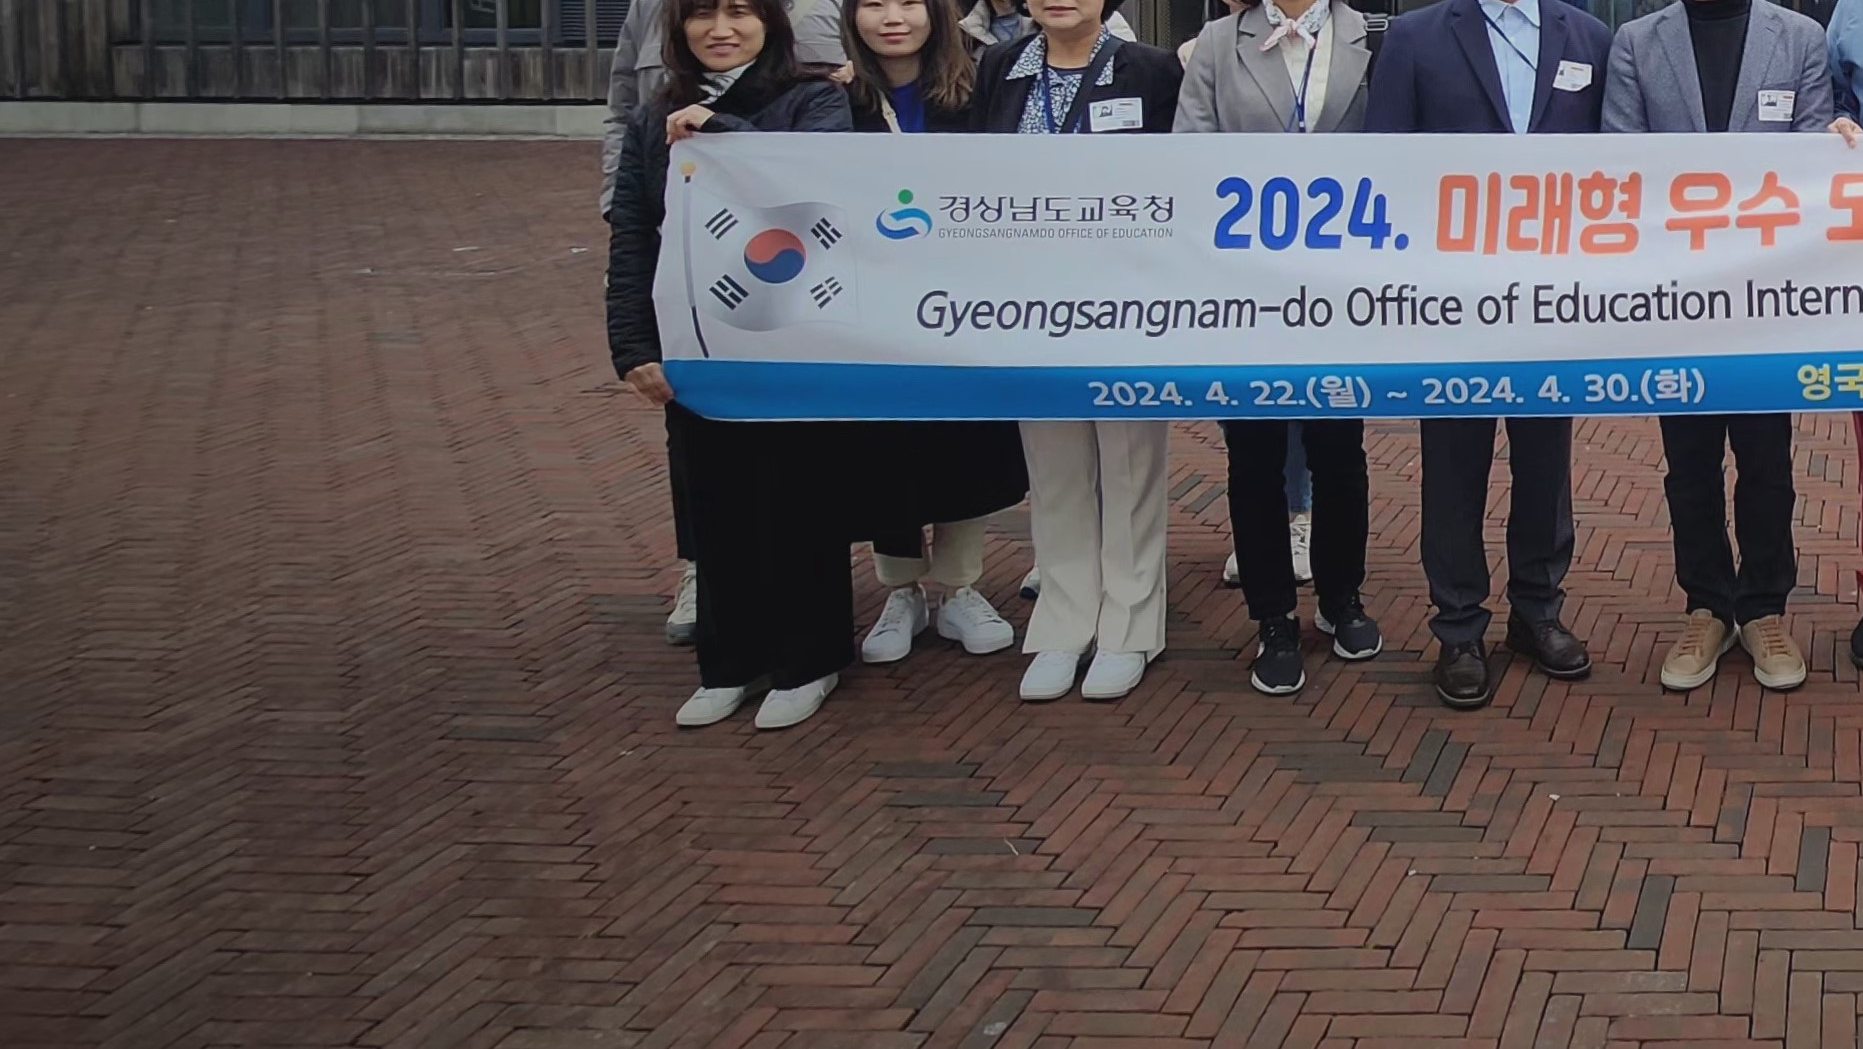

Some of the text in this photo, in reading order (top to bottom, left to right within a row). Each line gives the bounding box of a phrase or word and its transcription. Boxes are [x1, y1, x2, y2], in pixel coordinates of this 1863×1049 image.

[938, 194, 1175, 223] 경상남도교육청
[1213, 176, 1410, 251] 2024.
[1435, 172, 1642, 255] 미래형
[1664, 170, 1801, 250] 우수
[938, 227, 1174, 239] GYEONGSANGNAMDO OFFICE OF EDUCATION
[916, 285, 1334, 337] Gyeongsangnam-do
[1346, 284, 1463, 327] Office
[1477, 282, 1519, 325] of
[1532, 280, 1732, 325] Education
[1088, 381, 1193, 407] 2024.
[1204, 381, 1239, 407] 4.
[1252, 375, 1371, 410] 22.(월)
[1422, 378, 1524, 406] 2024.
[1537, 378, 1571, 403] 4.
[1584, 367, 1706, 406] 30.(화)
